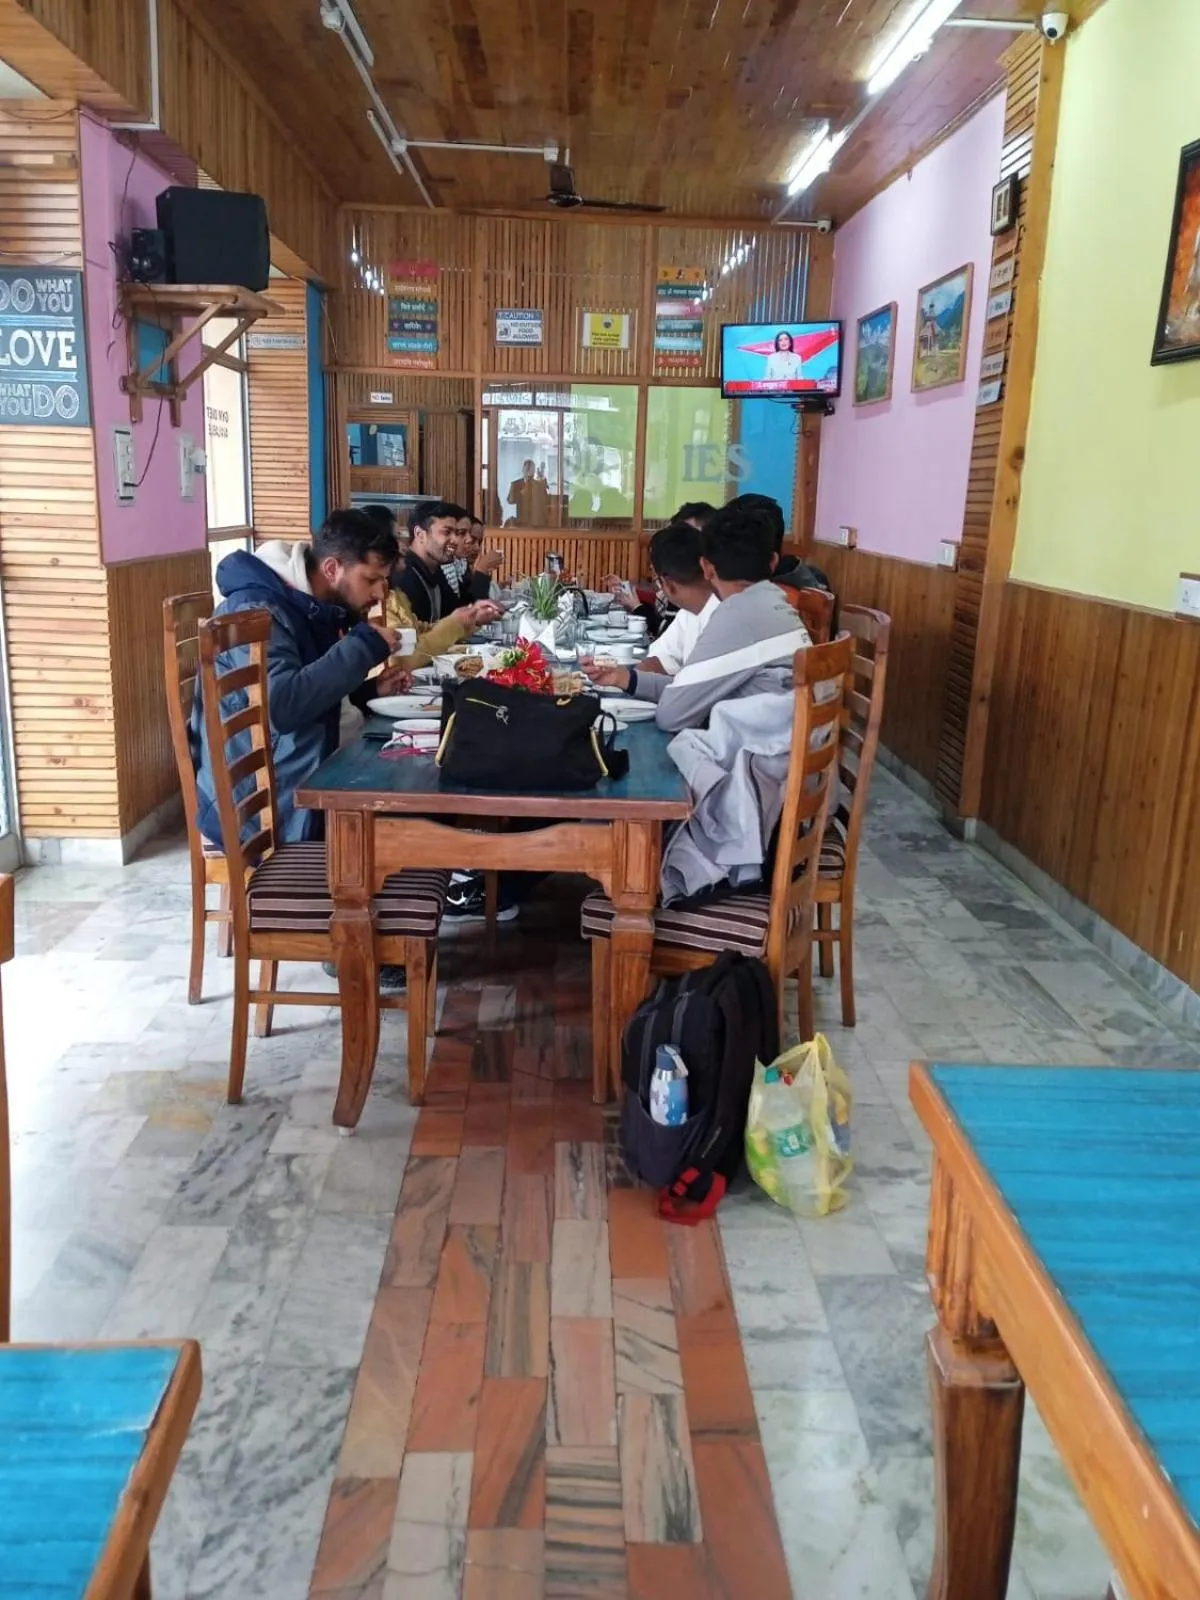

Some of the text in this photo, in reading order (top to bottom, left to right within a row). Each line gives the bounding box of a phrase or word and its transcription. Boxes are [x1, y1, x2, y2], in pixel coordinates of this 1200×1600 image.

[36, 278, 73, 292] WHAT
[37, 293, 74, 313] YOU
[0, 384, 31, 397] WHAT
[0, 397, 32, 416] YOU
[32, 384, 80, 419] DO
